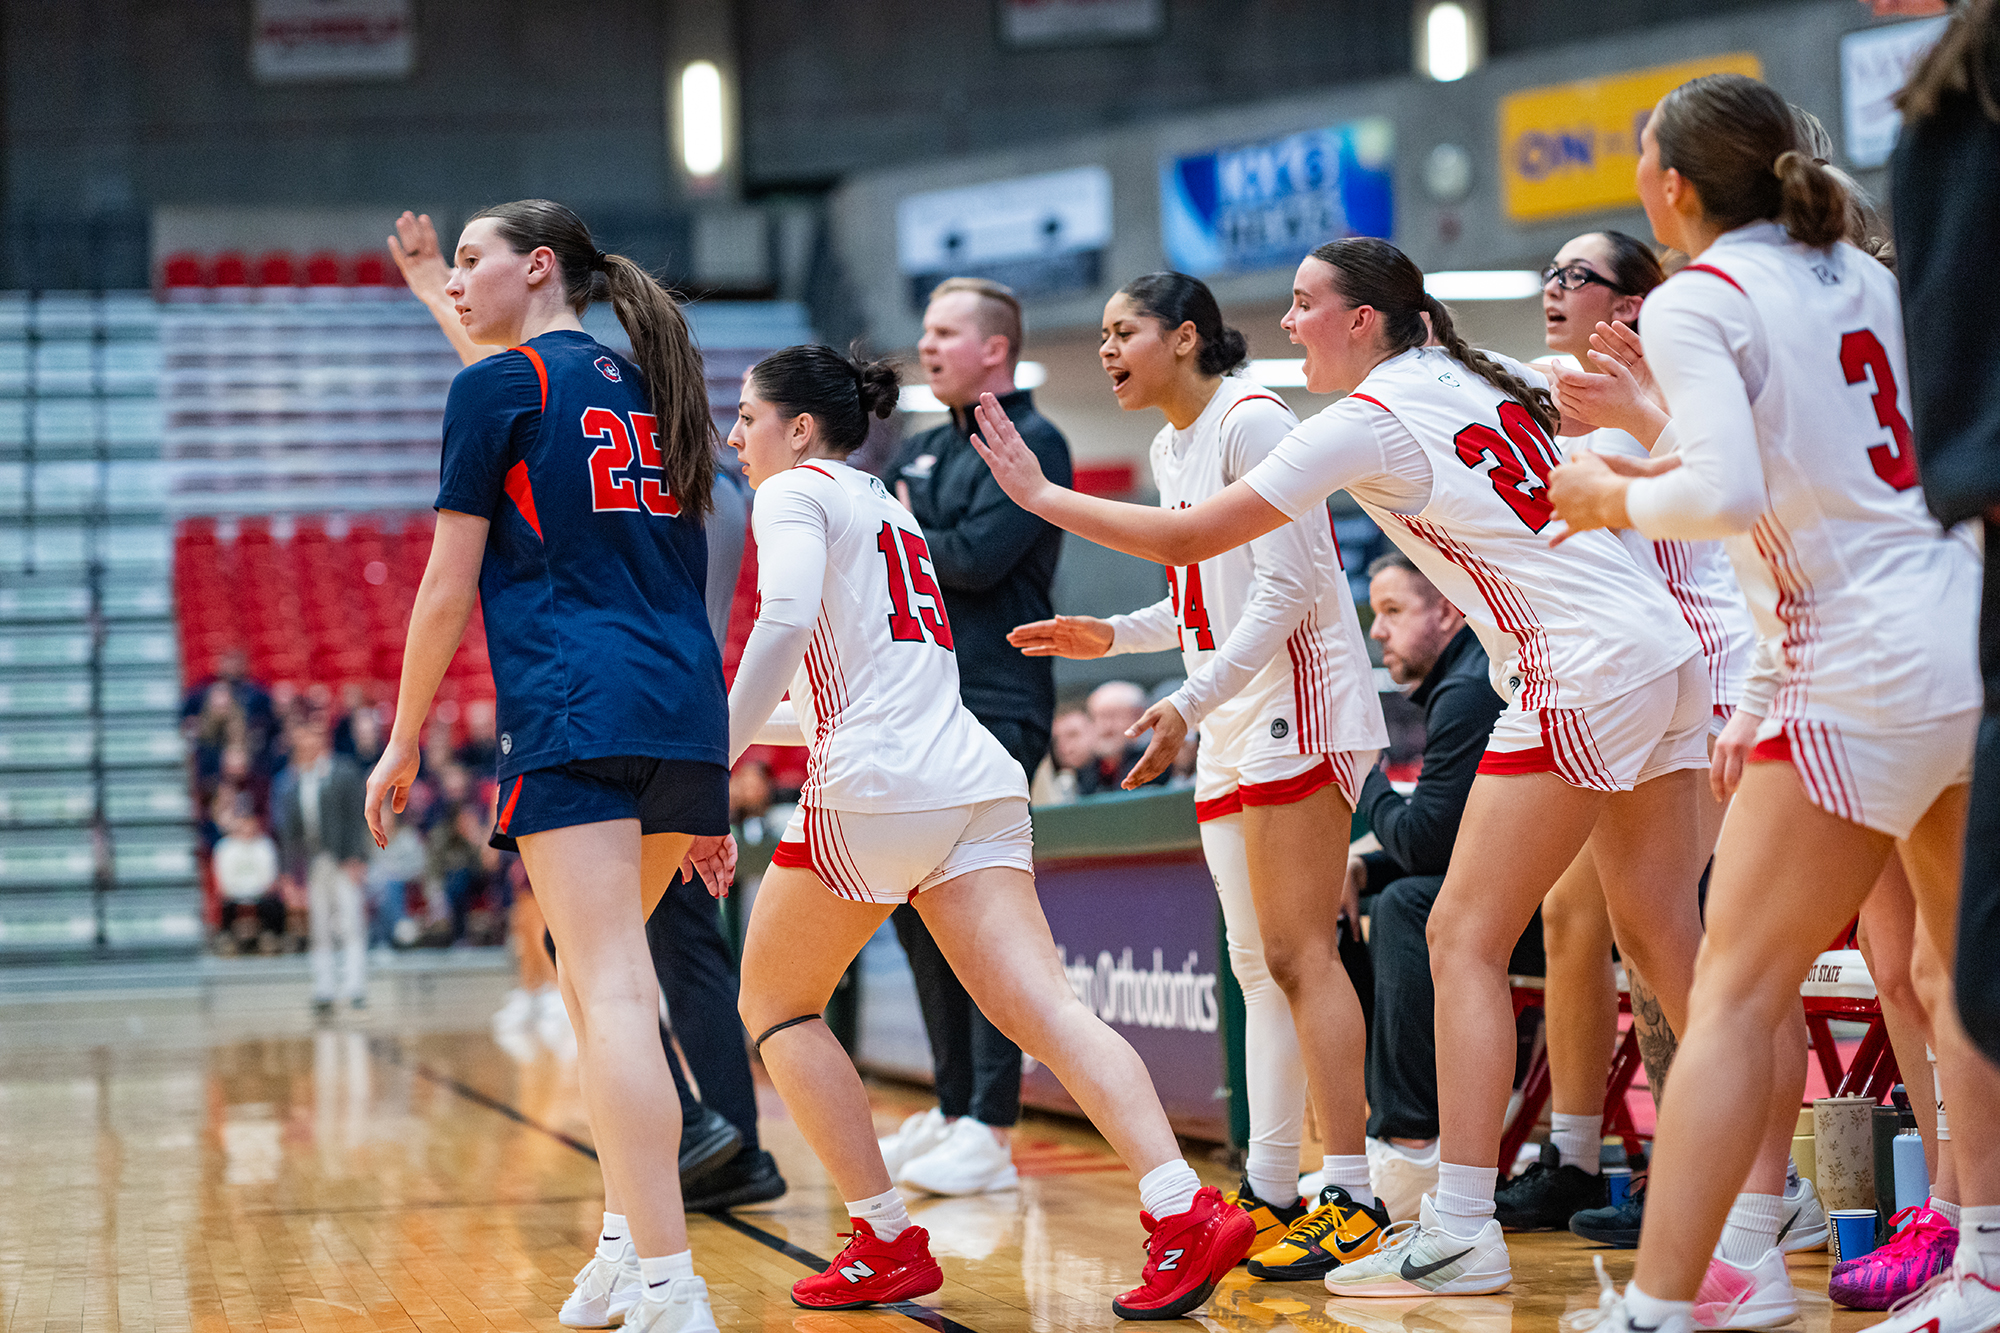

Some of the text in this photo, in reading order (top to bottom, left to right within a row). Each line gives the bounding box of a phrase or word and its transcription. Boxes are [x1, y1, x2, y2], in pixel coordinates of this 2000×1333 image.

[1839, 327, 1920, 491] 3
[580, 406, 683, 518] 25
[1453, 399, 1562, 535] 20
[877, 519, 954, 653] 15
[1096, 947, 1219, 1032] Orthodontics
[1803, 965, 1843, 983] OT STATE
[838, 1260, 877, 1285] N
[1831, 1219, 1842, 1264] OWERADE
